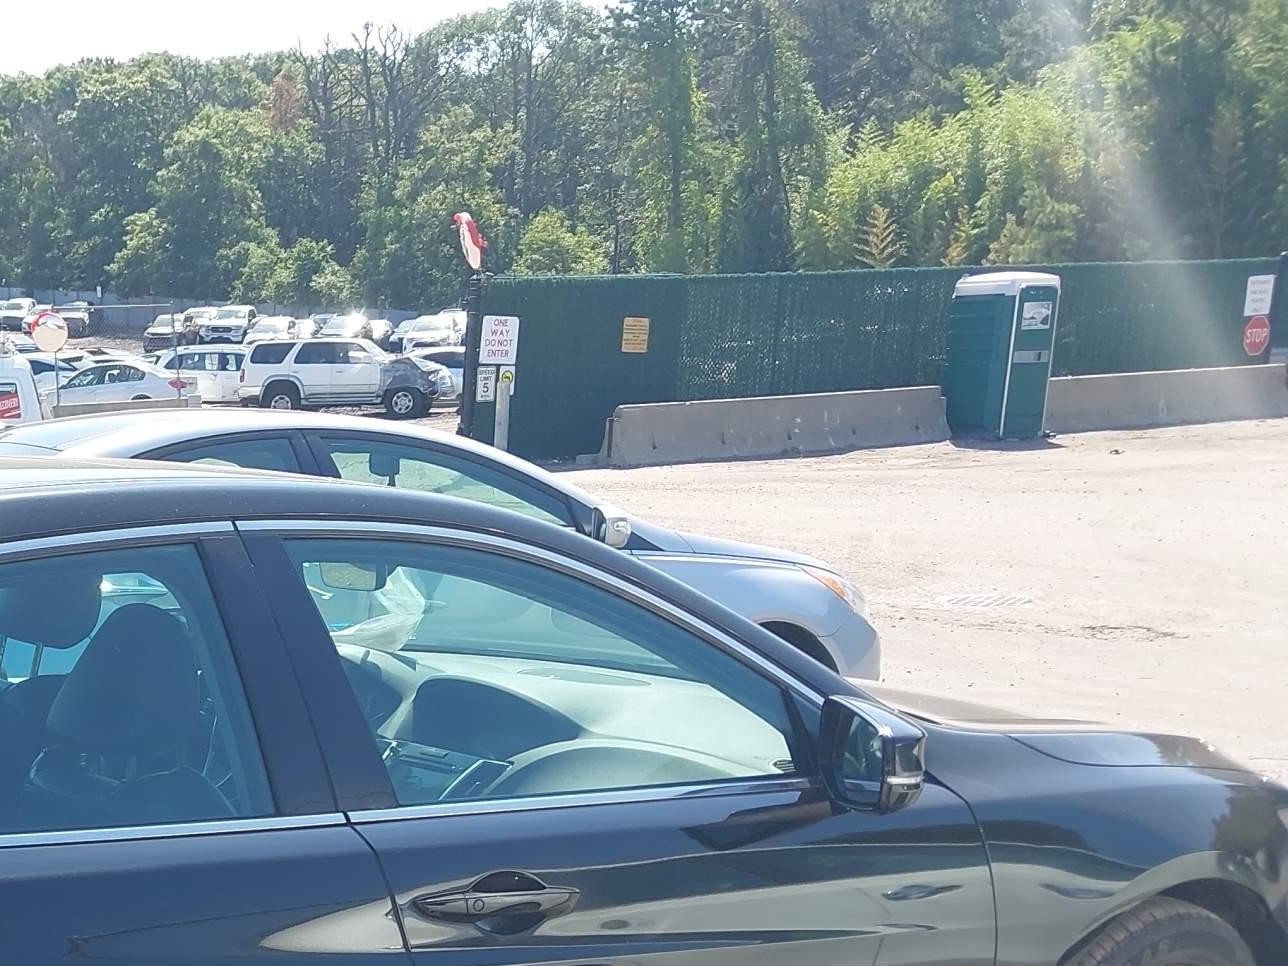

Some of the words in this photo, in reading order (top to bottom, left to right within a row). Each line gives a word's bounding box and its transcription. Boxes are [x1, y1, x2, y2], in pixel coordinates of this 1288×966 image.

[493, 319, 509, 327] ONE
[491, 329, 510, 337] WAY
[1246, 328, 1268, 343] STOP
[485, 339, 497, 347] DO
[498, 339, 513, 347] NOT
[487, 350, 509, 358] ENTER
[482, 382, 489, 394] 5
